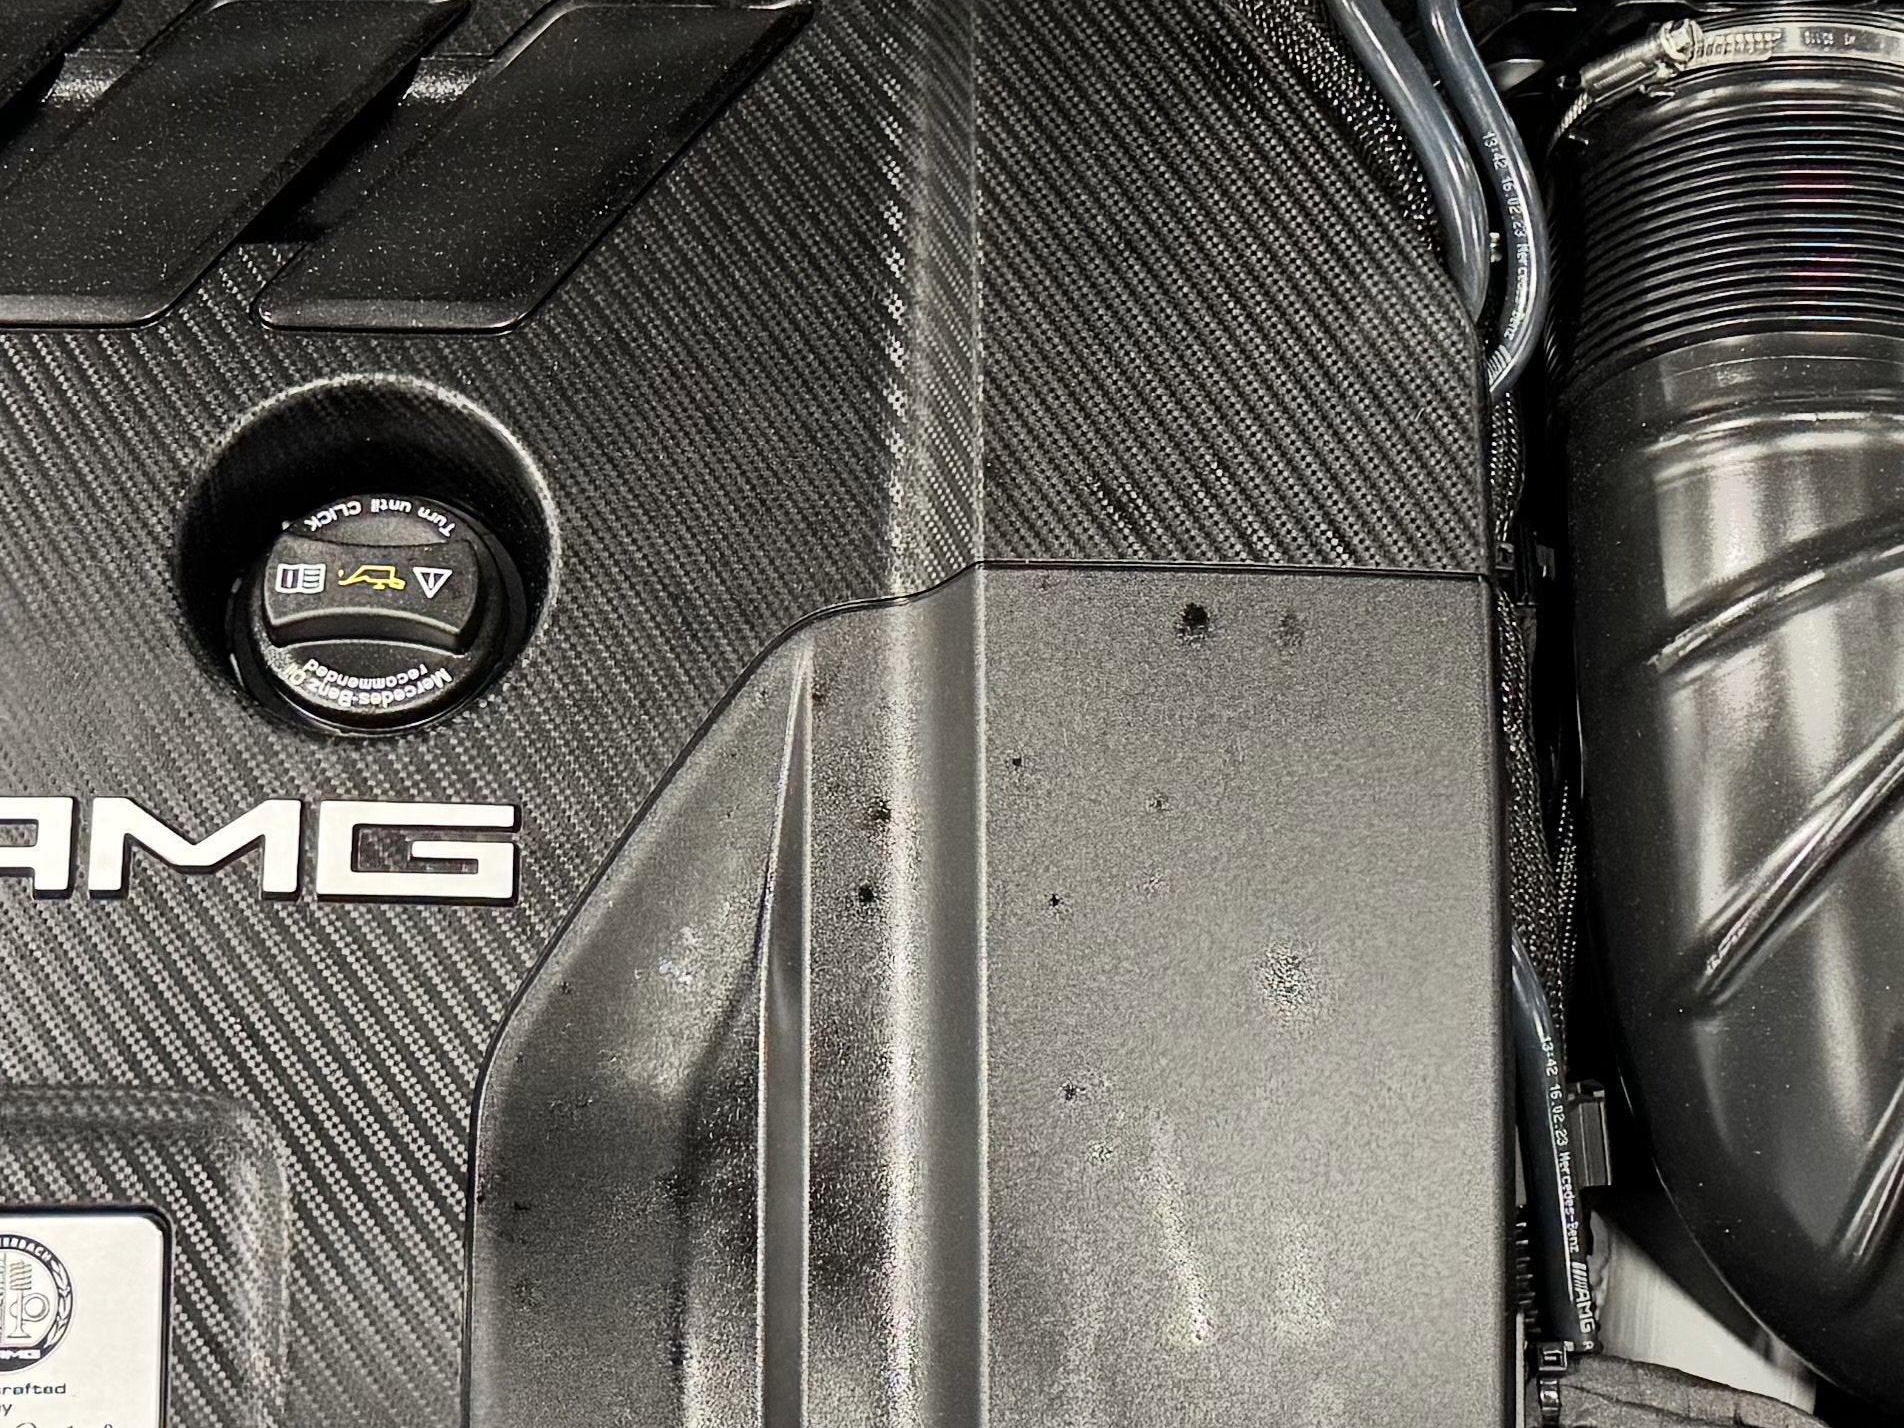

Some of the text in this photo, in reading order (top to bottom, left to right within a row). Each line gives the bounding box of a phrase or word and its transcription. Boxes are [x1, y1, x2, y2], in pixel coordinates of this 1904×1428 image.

[1482, 131, 1508, 171] 13:42
[1501, 175, 1527, 238] 16.02.23
[303, 497, 456, 537] Turn until CLICK
[301, 658, 429, 691] recommended
[311, 667, 454, 709] Mercedes-Benz
[1541, 1035, 1559, 1077] 13:42
[1549, 1083, 1569, 1147] 16.02.23
[1558, 1151, 1580, 1253] Mercedes-Benz
